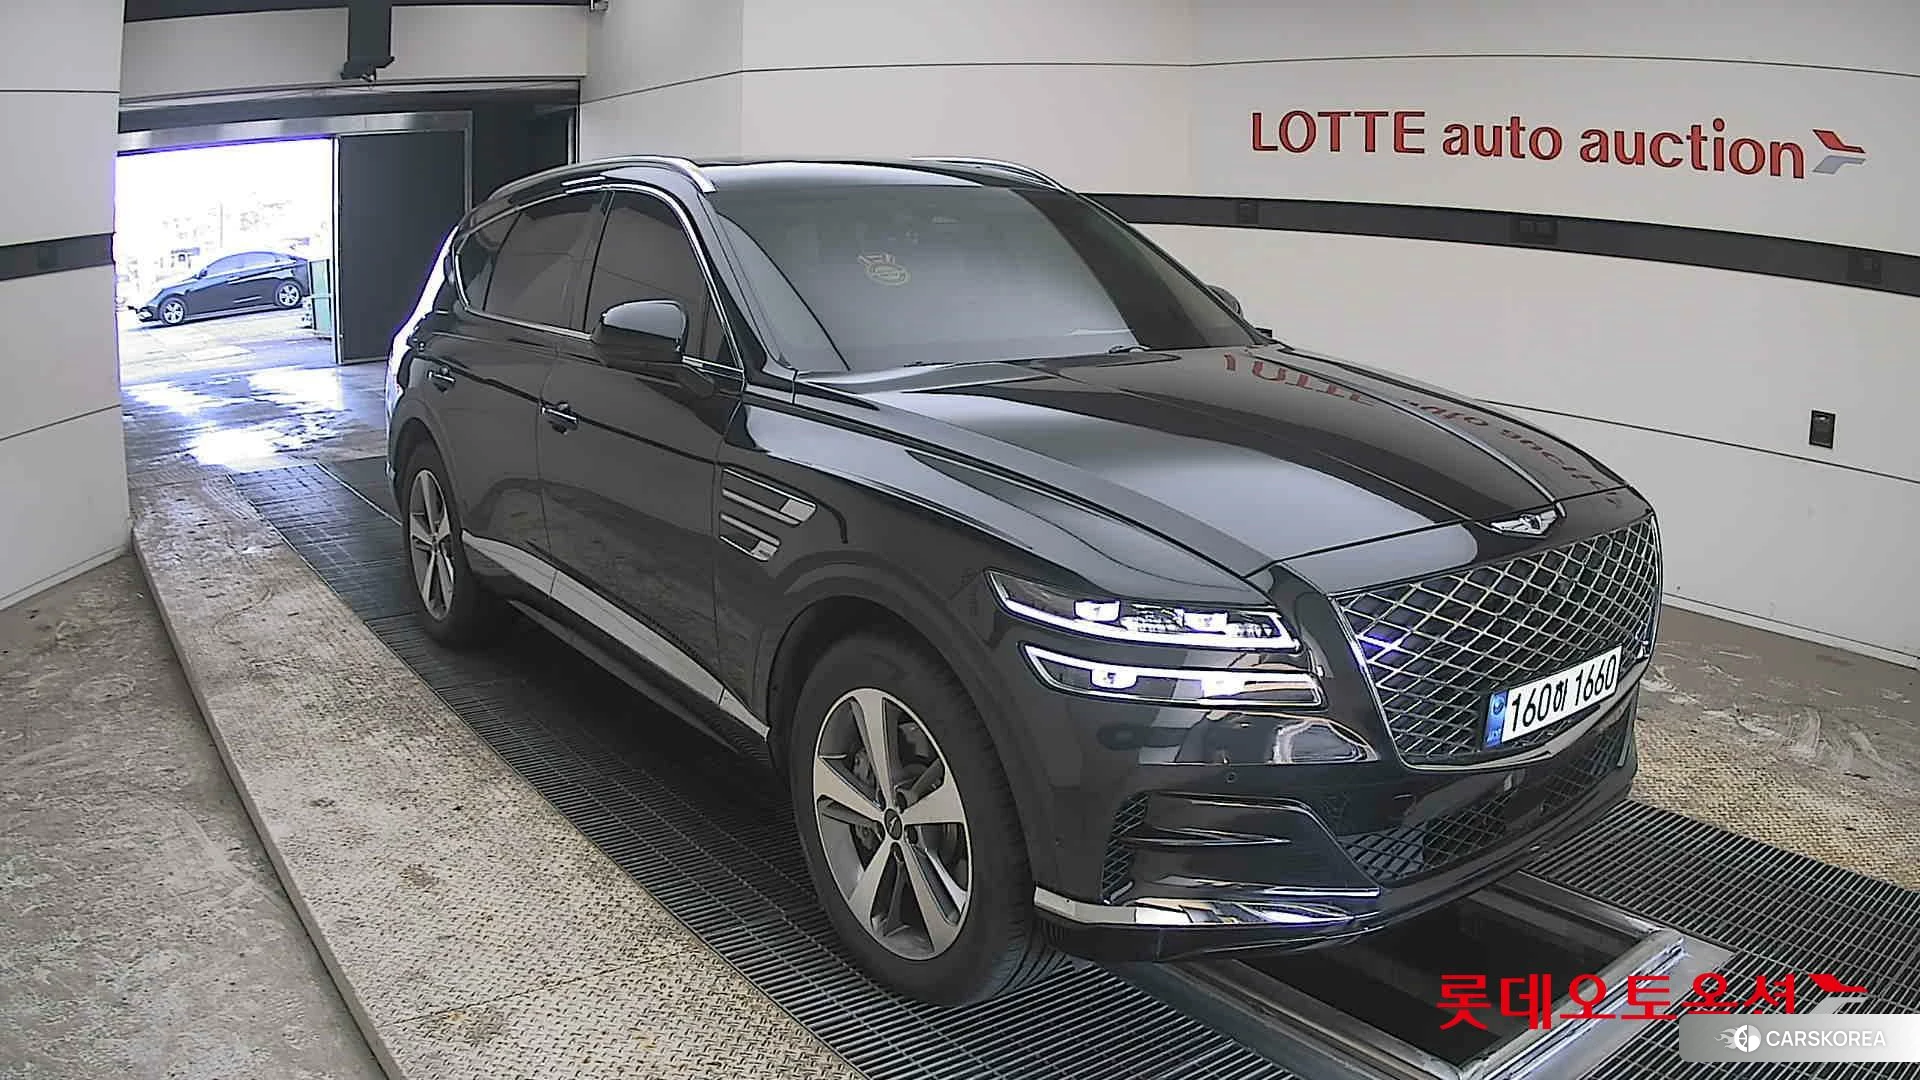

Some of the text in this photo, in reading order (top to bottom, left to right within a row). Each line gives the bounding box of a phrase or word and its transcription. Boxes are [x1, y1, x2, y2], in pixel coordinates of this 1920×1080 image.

[1251, 110, 1805, 178] LOTTE auto auction
[1575, 654, 1617, 706] 1660
